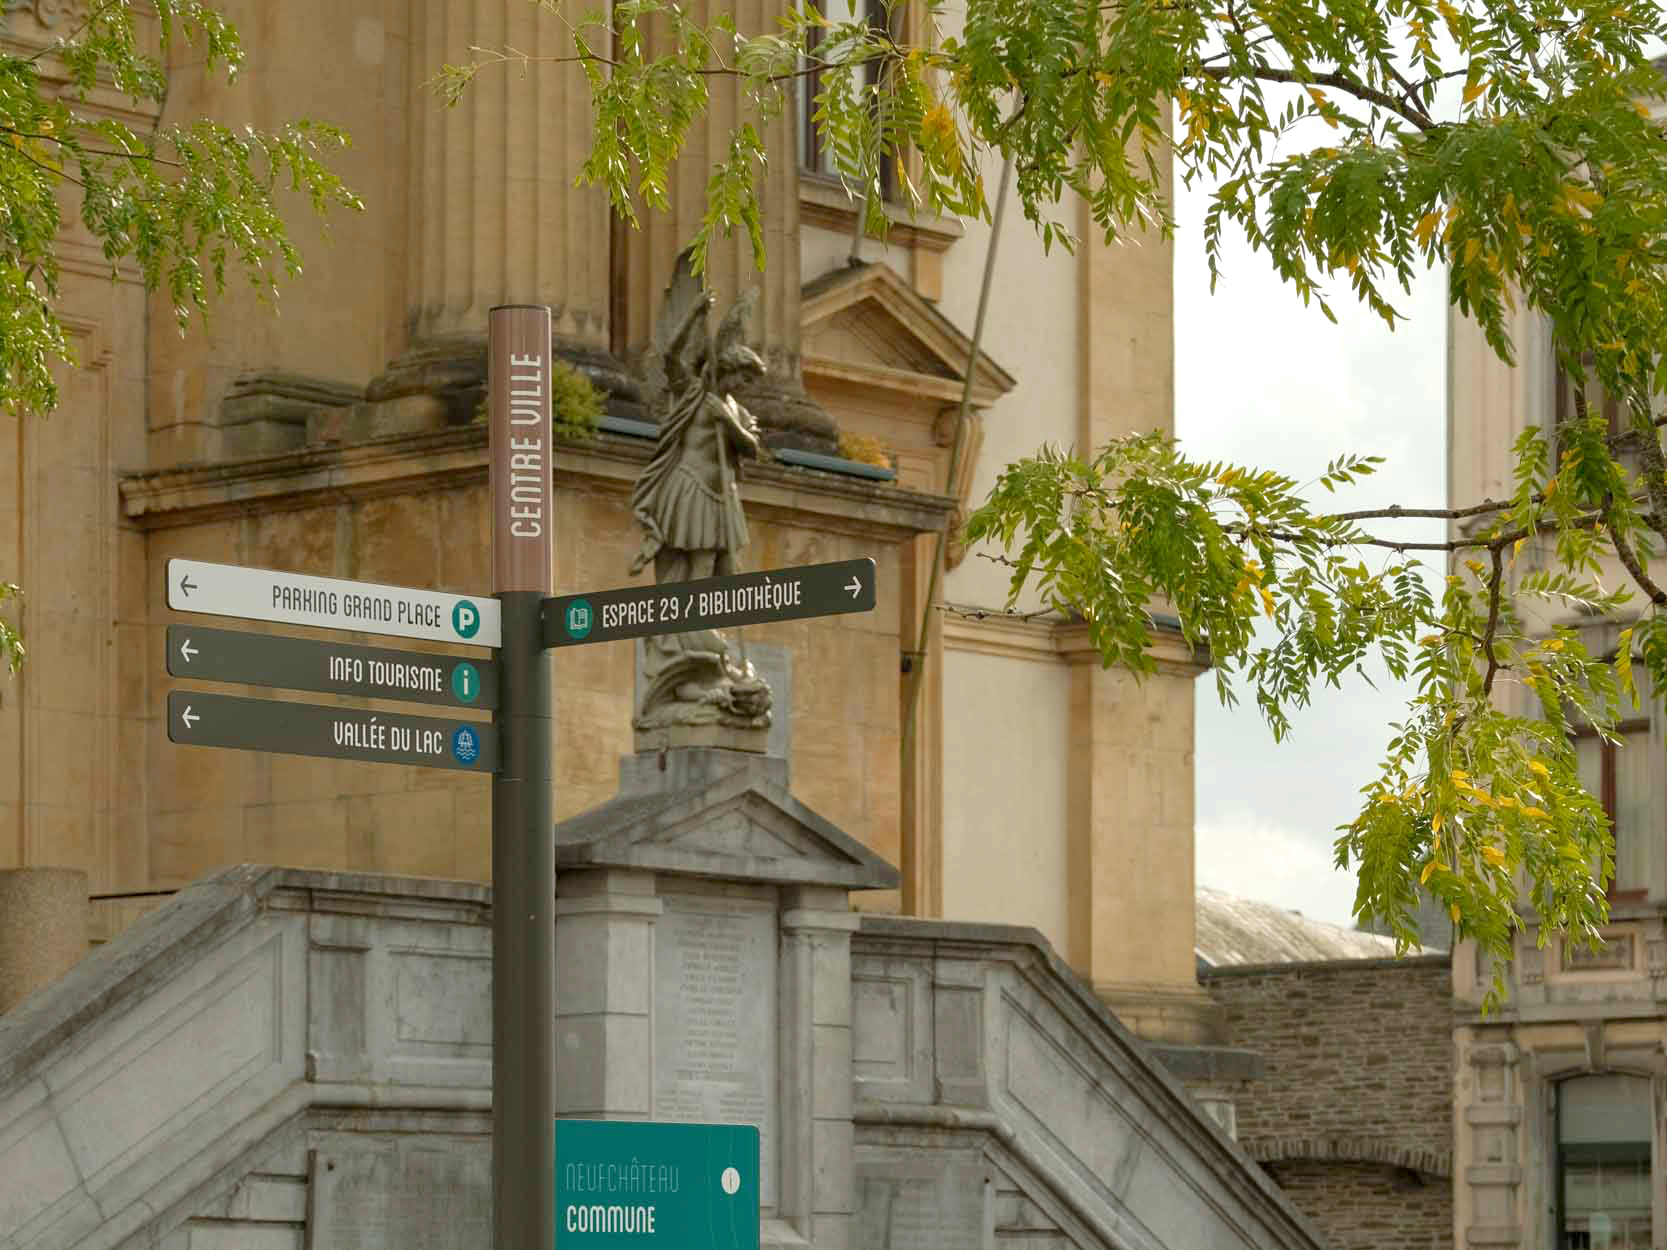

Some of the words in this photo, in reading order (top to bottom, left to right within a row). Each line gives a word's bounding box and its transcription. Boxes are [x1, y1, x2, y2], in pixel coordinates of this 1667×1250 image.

[510, 354, 542, 425] VILLE
[510, 437, 542, 537] CENTRE
[272, 585, 338, 615] PARKING
[343, 594, 392, 622] GRAND
[398, 600, 441, 628] PLACE
[458, 607, 475, 631] P
[602, 599, 655, 629] ESPACE
[660, 596, 679, 621] 29
[684, 594, 694, 619] /
[699, 576, 801, 617] BIBLIOTHÈQUE
[329, 656, 363, 683] INFO
[368, 660, 443, 692] TOURISME
[463, 669, 469, 696] i
[333, 717, 385, 749] VALLÉE
[391, 727, 410, 751] DU
[415, 731, 443, 755] LAC
[566, 1156, 680, 1193] NEUFCHÂTEAU
[566, 1205, 655, 1233] COMMUNE
